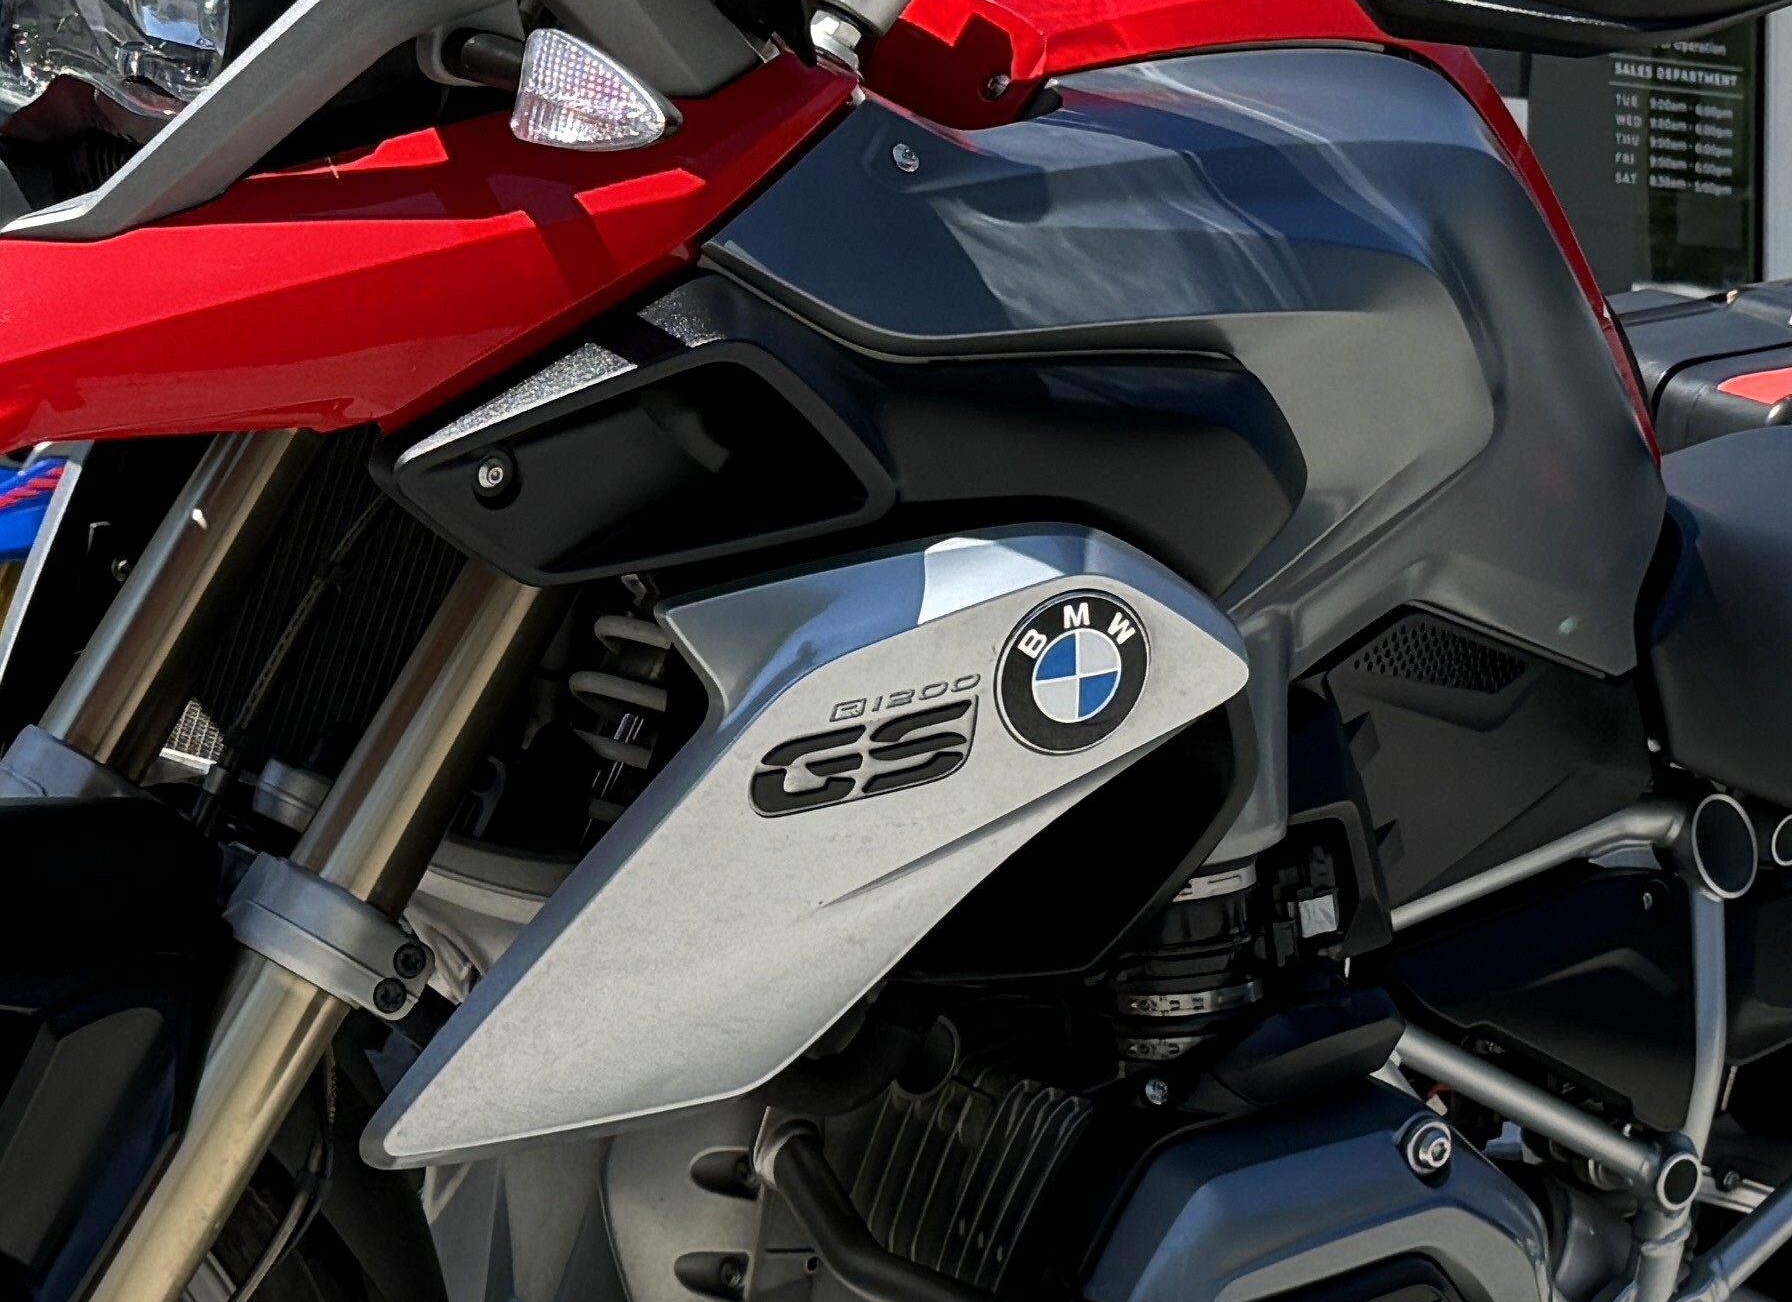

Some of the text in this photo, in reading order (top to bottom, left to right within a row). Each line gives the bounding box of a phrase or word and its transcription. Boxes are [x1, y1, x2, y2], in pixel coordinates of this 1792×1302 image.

[1614, 61, 1739, 87] SALES DEPARTMENT
[1615, 172, 1637, 185] SAT
[1017, 601, 1137, 658] BMW
[829, 673, 982, 723] R1200
[749, 697, 979, 818] GS
